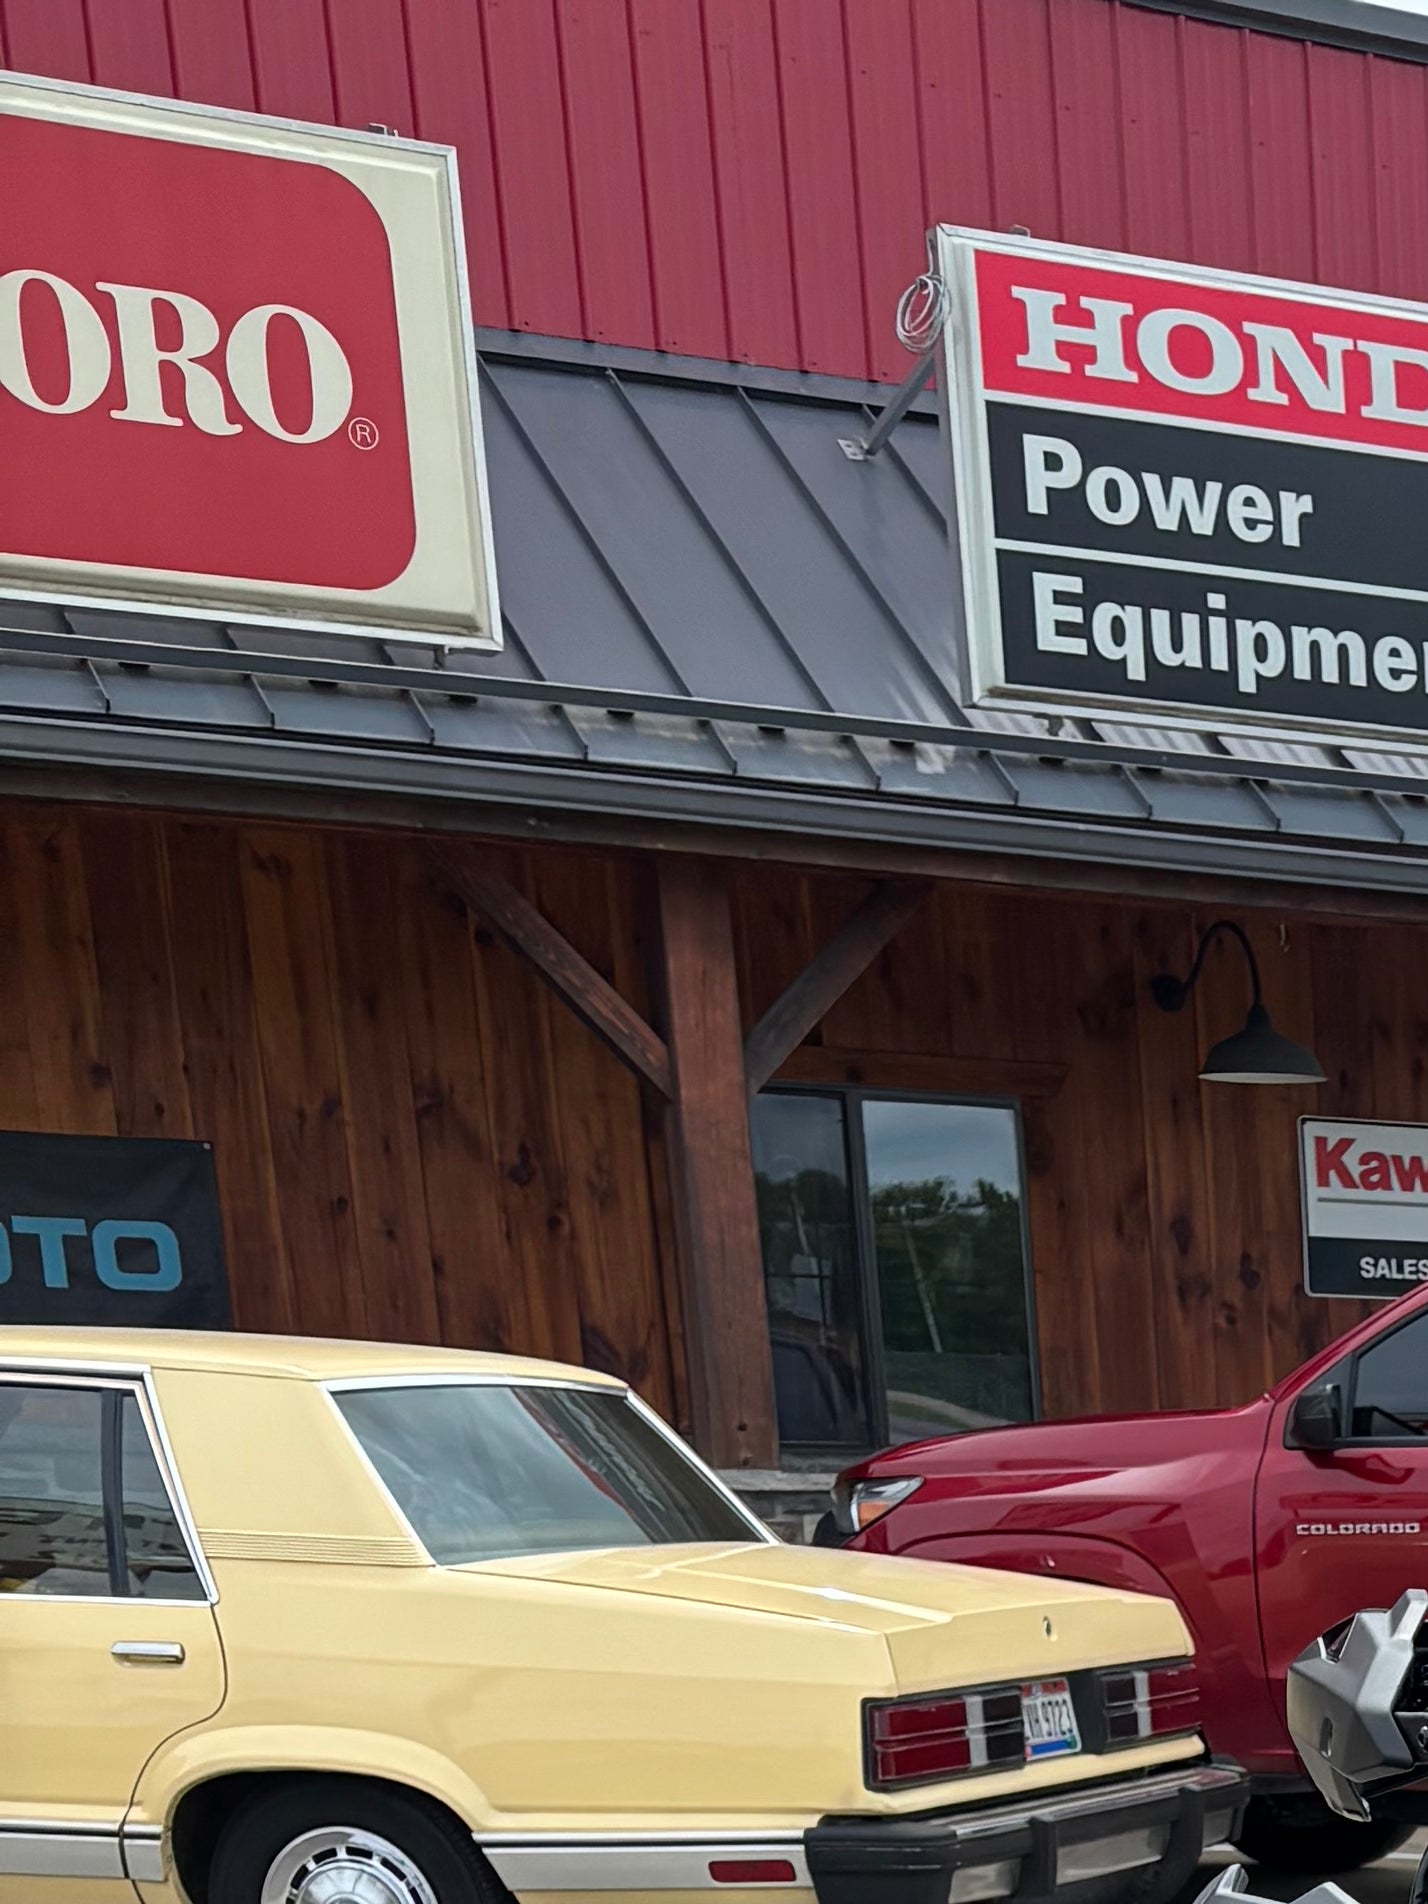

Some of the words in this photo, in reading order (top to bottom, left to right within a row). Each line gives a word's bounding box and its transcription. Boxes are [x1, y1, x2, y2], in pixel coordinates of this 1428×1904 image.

[0, 269, 353, 445] ORO
[1021, 432, 1314, 548] Power
[0, 1215, 183, 1291] TO
[1296, 1523, 1420, 1536] COLORADO
